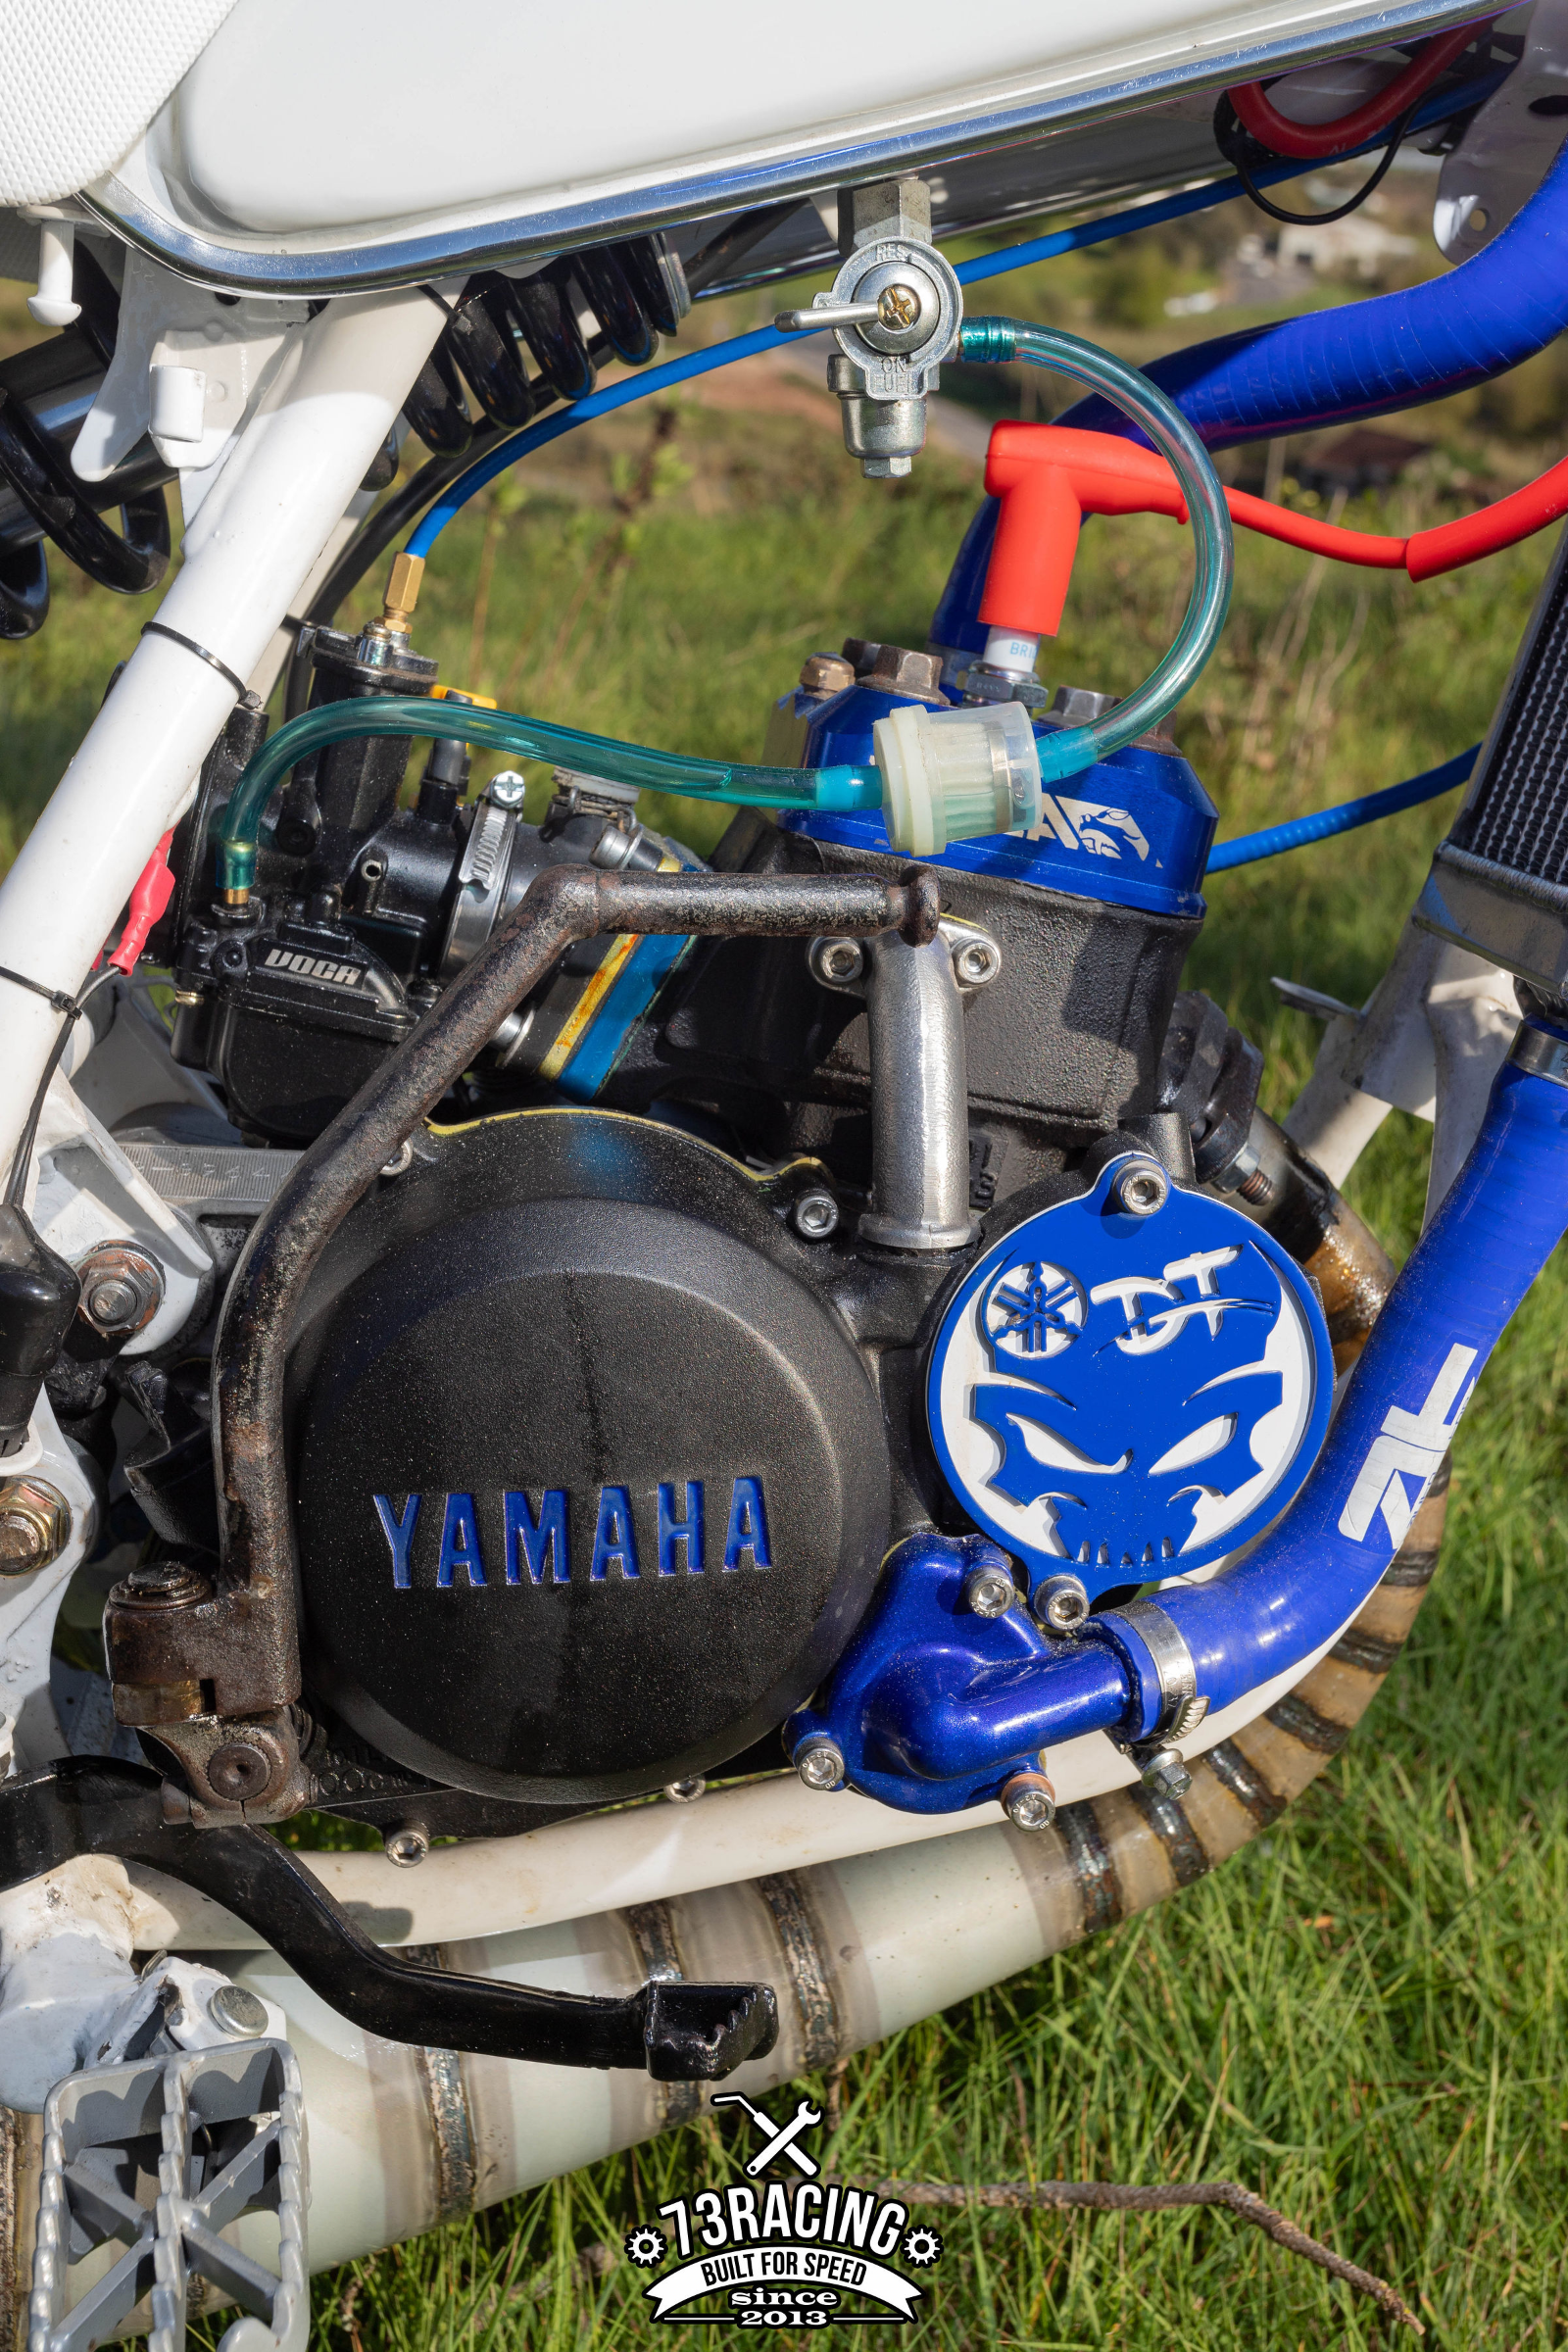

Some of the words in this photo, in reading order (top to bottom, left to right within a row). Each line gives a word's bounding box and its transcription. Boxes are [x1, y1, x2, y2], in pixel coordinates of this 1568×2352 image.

[882, 356, 907, 372] ON
[264, 948, 362, 986] VOCA
[372, 1476, 772, 1589] YAMAHA
